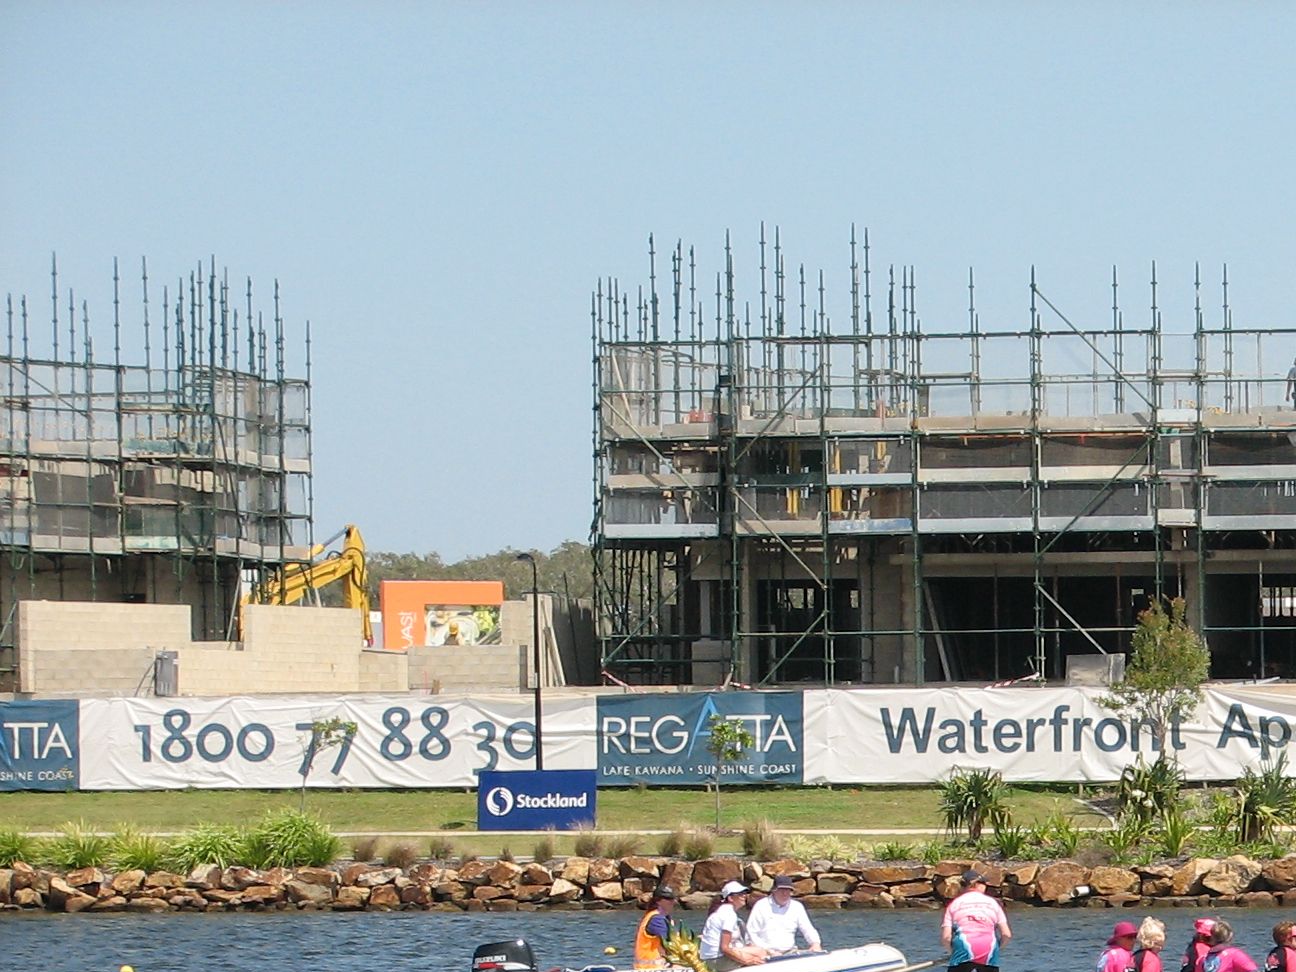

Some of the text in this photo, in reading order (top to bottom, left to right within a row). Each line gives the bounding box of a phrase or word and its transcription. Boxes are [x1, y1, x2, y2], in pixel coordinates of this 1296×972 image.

[0, 722, 73, 761] TTA
[133, 706, 540, 776] 1800 77 88 30
[880, 704, 1186, 754] Waterfront
[603, 765, 630, 776] LAKE
[635, 765, 684, 776] KAWANA
[759, 763, 796, 775] COAST
[516, 792, 587, 809] Stockland
